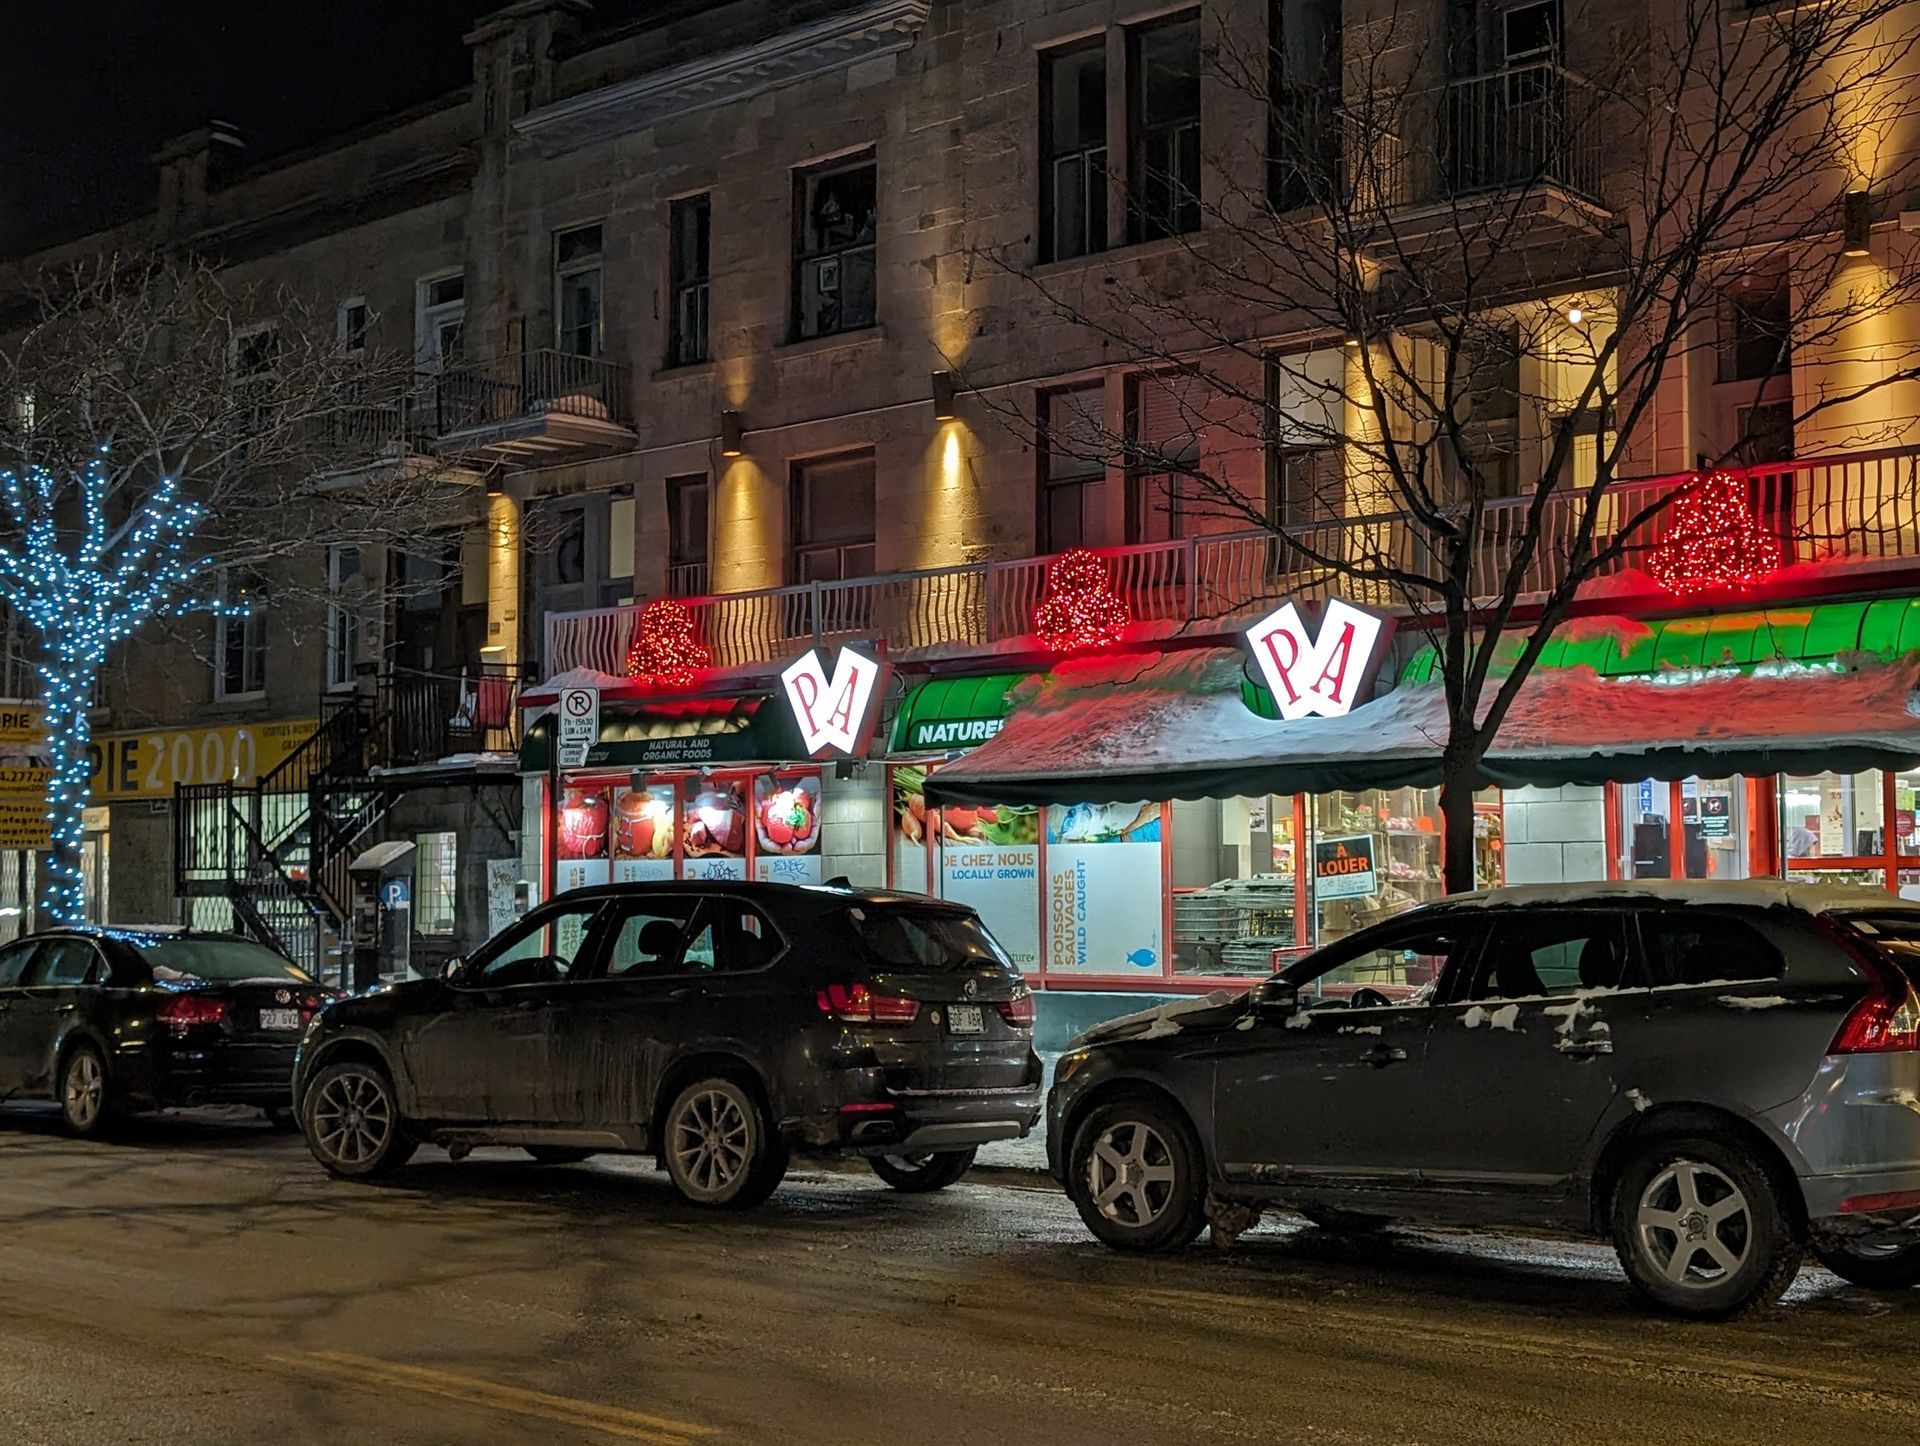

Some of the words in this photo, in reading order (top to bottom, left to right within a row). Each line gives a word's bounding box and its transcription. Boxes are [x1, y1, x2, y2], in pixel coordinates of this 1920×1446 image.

[643, 750, 681, 761] ORGANIC
[683, 749, 712, 759] FOODS
[649, 740, 688, 750] NATURAL
[690, 738, 710, 748] AND
[145, 728, 256, 790] 2000
[952, 869, 994, 879] LOCALLY
[997, 868, 1035, 879] GROWN
[961, 854, 994, 867] CHEZ
[998, 853, 1034, 866] NOUS
[1318, 856, 1368, 876] LOUER
[1077, 859, 1086, 921] CAUGHT
[1053, 873, 1064, 965] POISSONS
[1065, 868, 1075, 966] SAUVAGES
[1077, 926, 1086, 965] WILD
